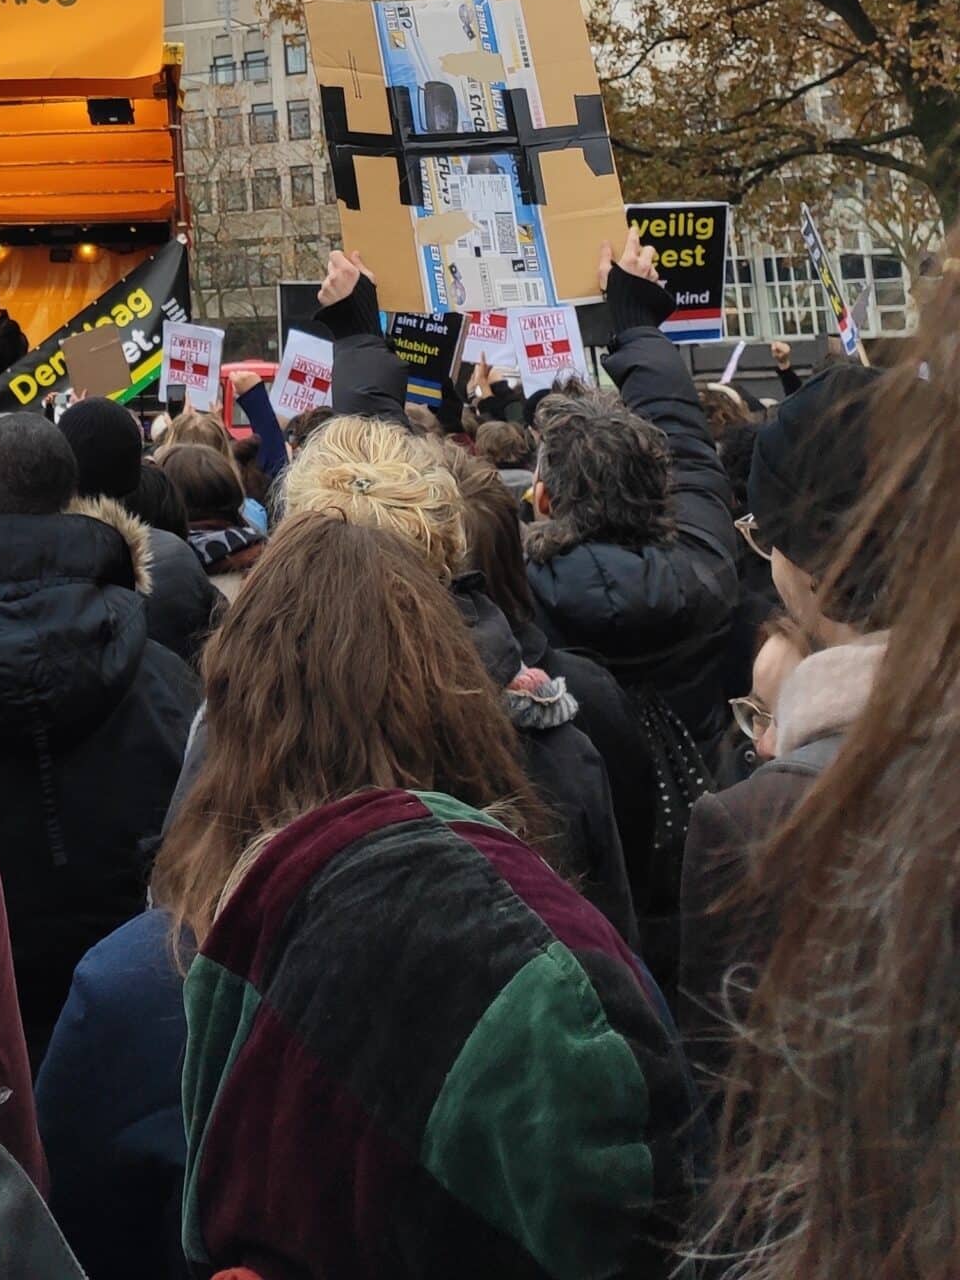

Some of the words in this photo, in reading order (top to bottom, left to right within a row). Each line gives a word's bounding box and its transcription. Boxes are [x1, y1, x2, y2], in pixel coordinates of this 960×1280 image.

[676, 290, 711, 305] kind
[397, 316, 417, 328] sint
[426, 322, 449, 335] piet
[481, 312, 490, 326] IS
[522, 313, 564, 331] ZWARTE
[468, 325, 506, 341] ACISME
[534, 327, 556, 342] PIET
[171, 336, 210, 353] ZWARTE
[544, 342, 554, 356] IS
[179, 349, 200, 362] PIET
[184, 361, 193, 374] IS
[530, 357, 572, 371] RACISME
[169, 371, 207, 390] RACISME
[305, 374, 314, 388] IS
[295, 385, 316, 402] PIET
[281, 393, 314, 412] WARTE
